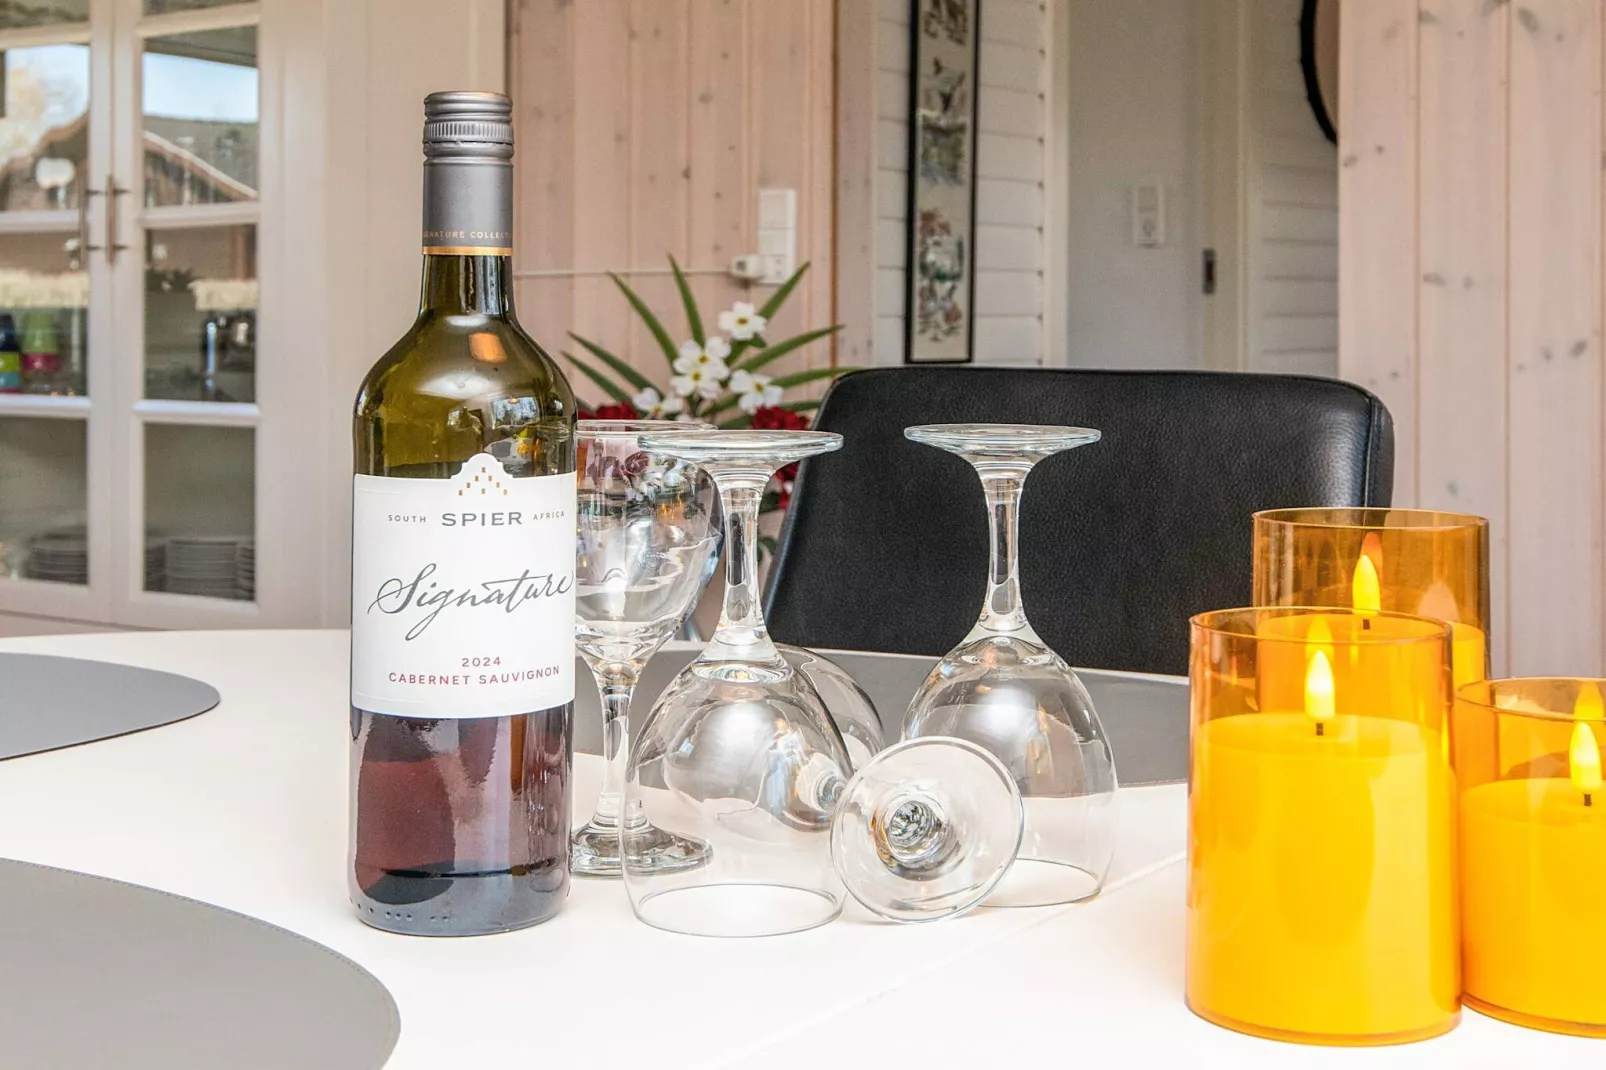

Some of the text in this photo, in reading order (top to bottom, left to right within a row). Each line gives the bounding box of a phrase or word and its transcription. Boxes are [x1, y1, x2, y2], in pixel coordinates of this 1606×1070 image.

[388, 510, 566, 527] SOUTH SPIER AFRICA
[367, 562, 574, 641] Signature
[461, 656, 502, 668] 2024
[388, 665, 560, 685] CABERNET SAUVIGNON
